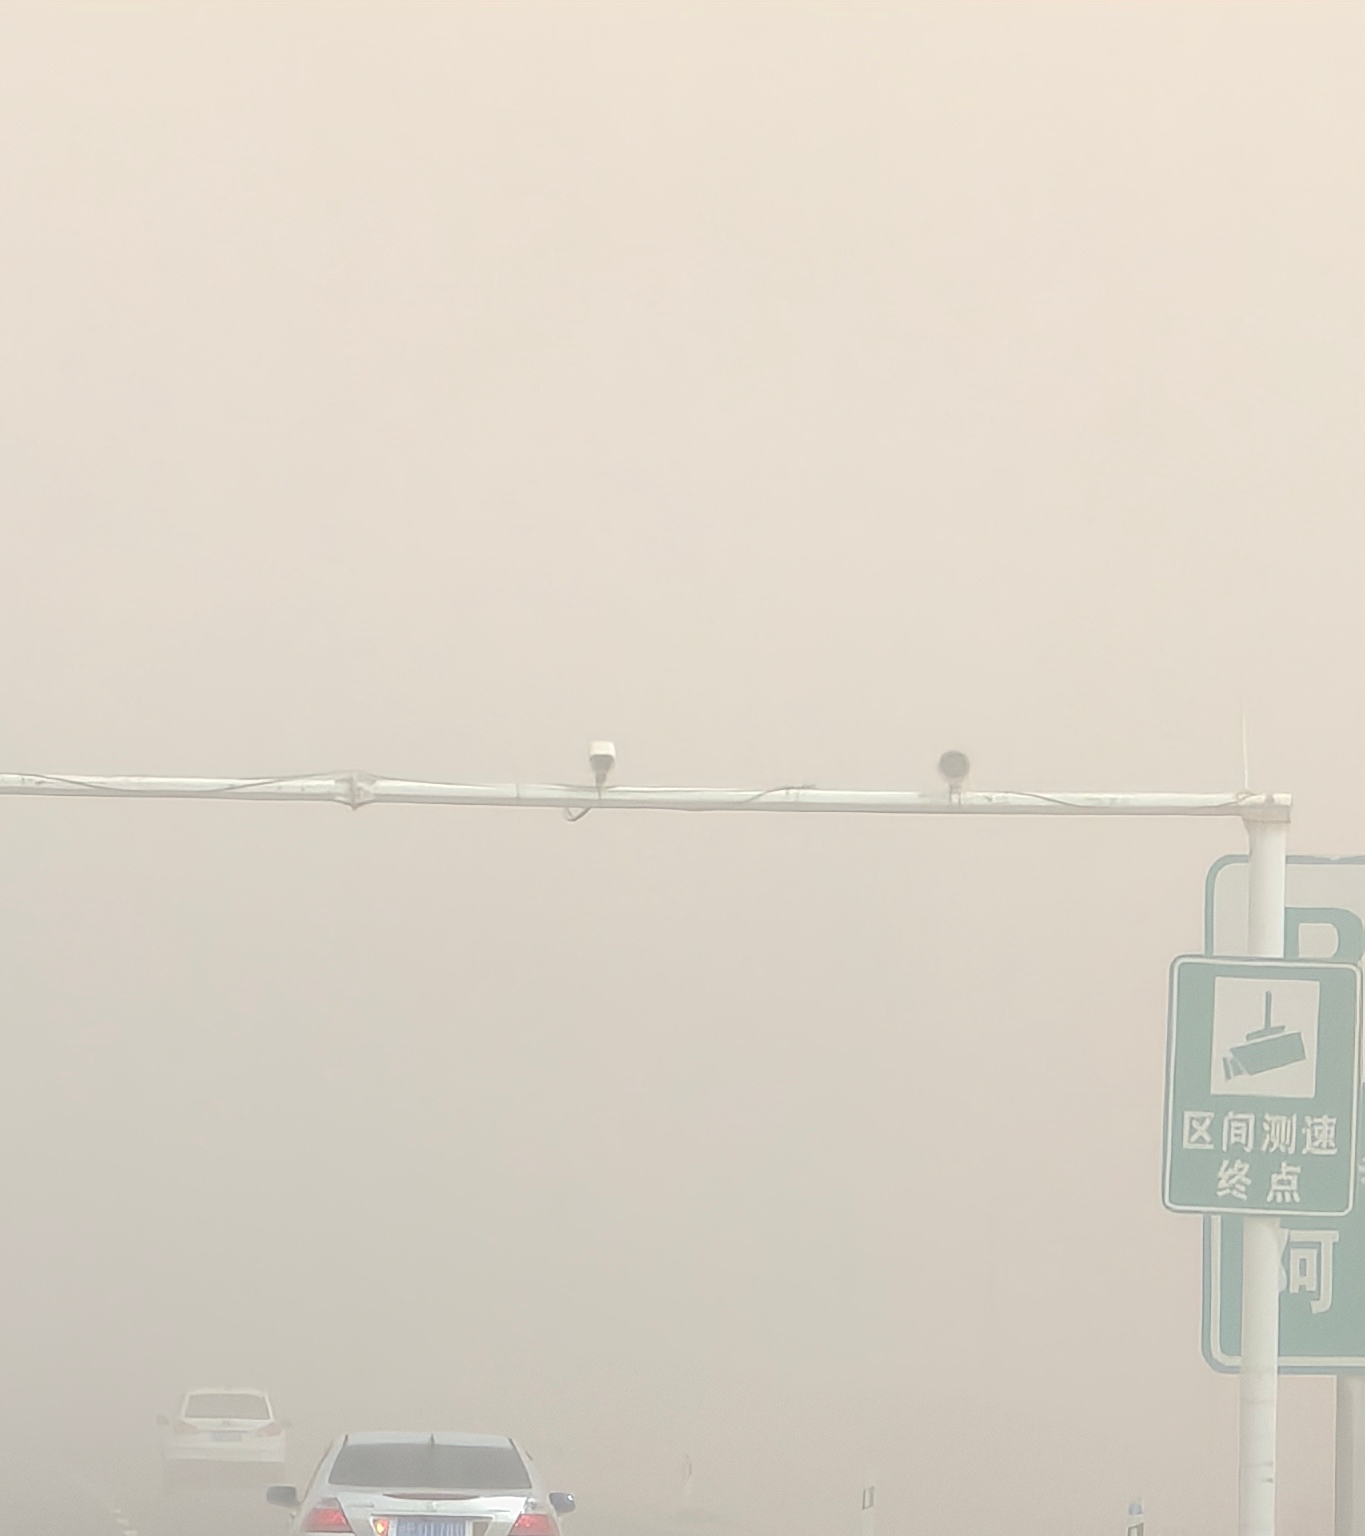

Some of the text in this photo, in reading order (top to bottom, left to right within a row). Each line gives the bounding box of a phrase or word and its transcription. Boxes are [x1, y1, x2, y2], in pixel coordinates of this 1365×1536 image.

[1182, 1110, 1338, 1155] 区间测速
[1216, 1159, 1301, 1203] 终点
